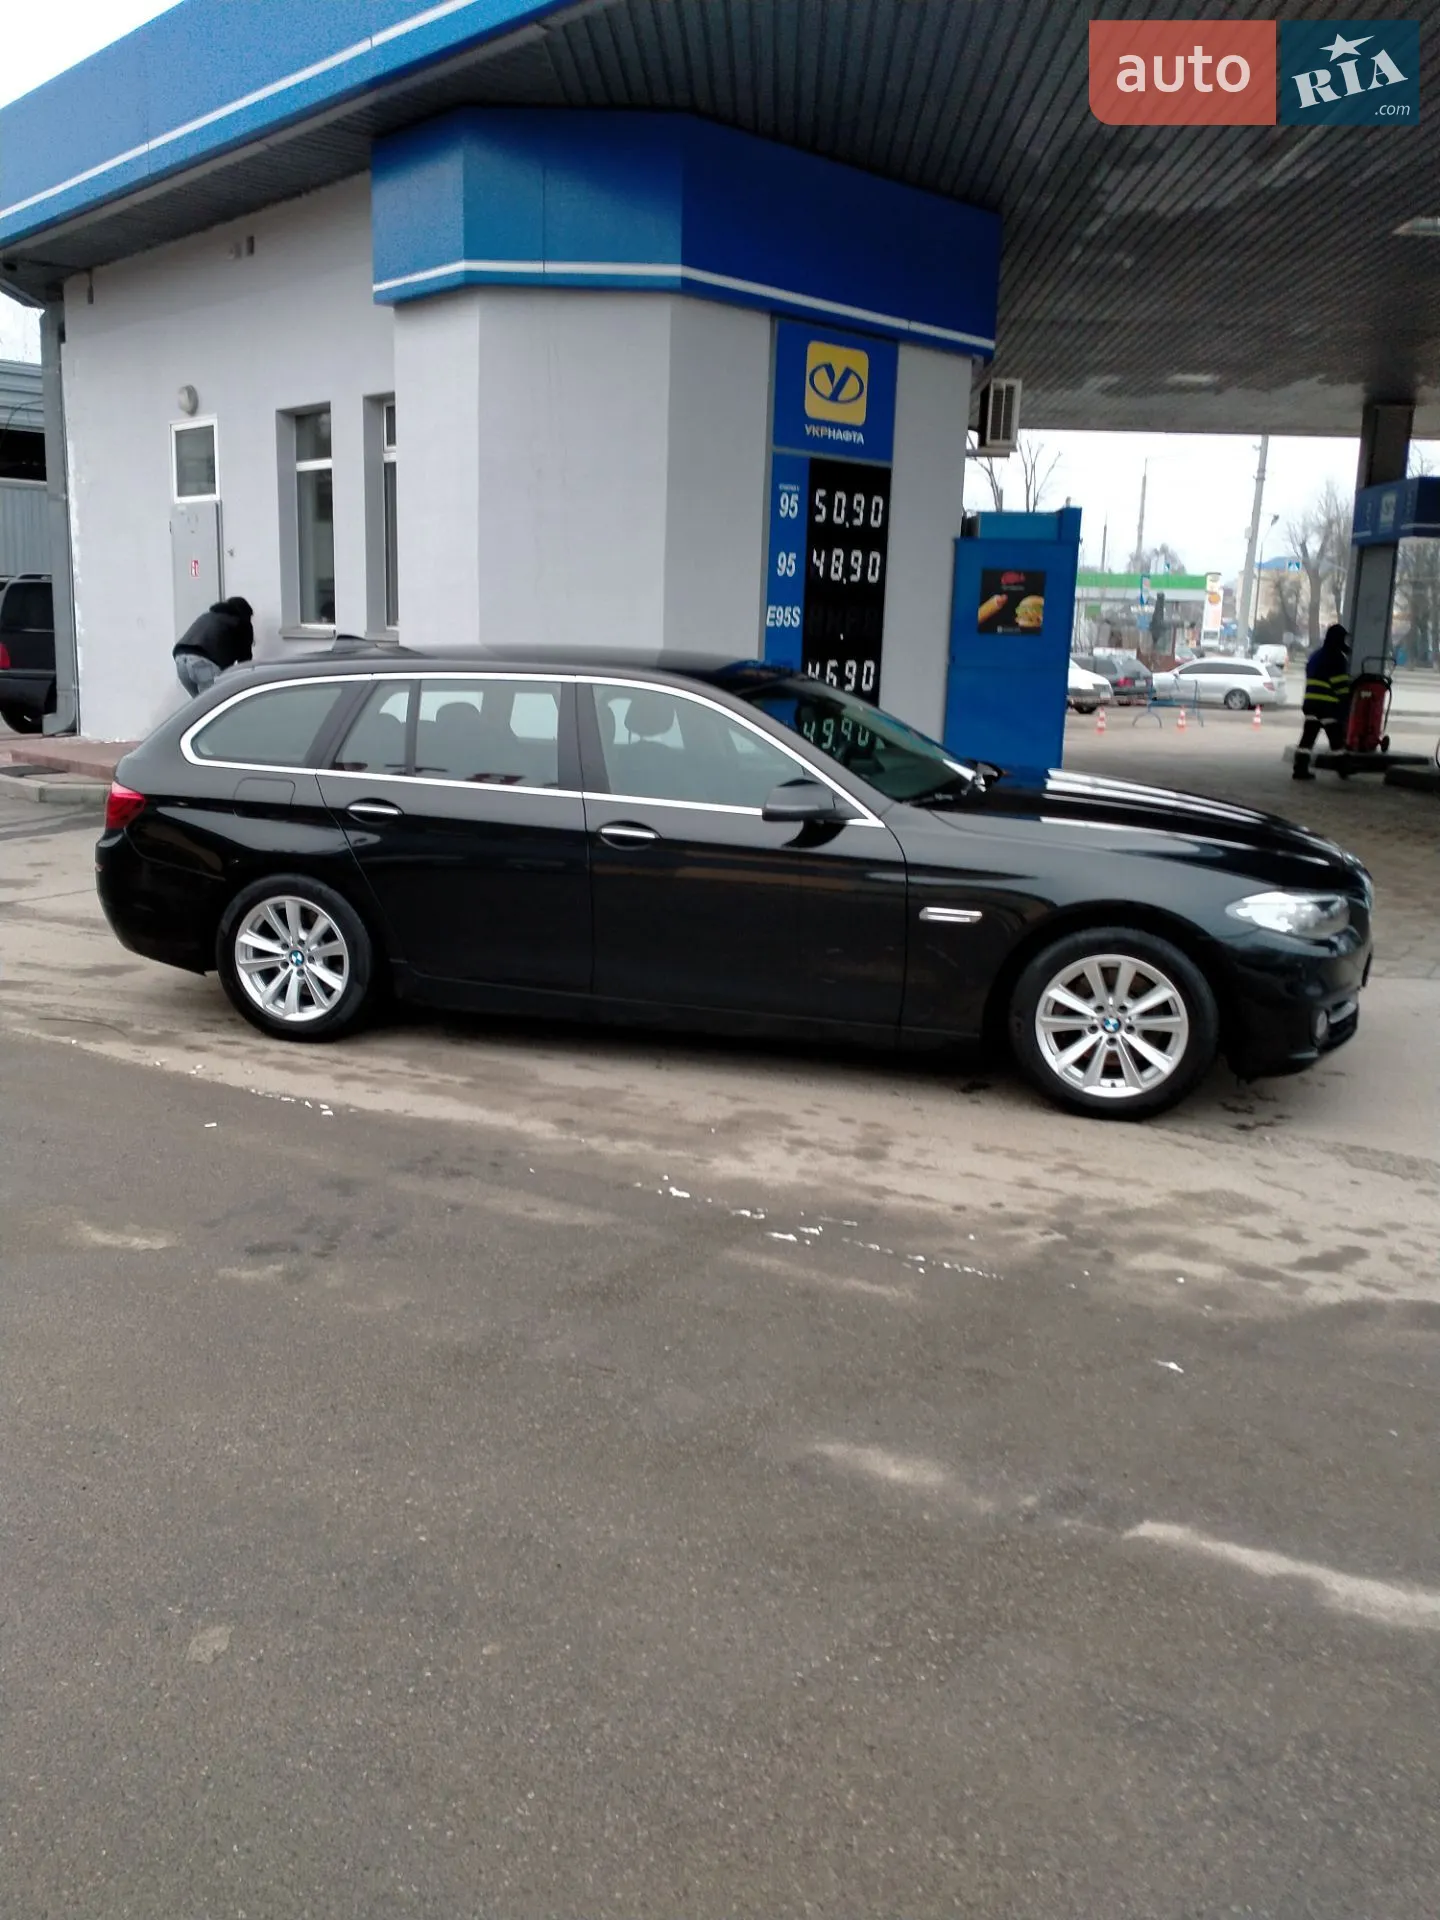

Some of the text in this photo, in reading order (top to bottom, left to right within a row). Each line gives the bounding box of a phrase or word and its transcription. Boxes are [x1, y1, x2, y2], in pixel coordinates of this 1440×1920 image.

[804, 423, 865, 445] УКРНАФТА
[779, 488, 884, 528] 95 50.90
[776, 547, 881, 585] 95 48.90
[766, 605, 801, 628] E95S
